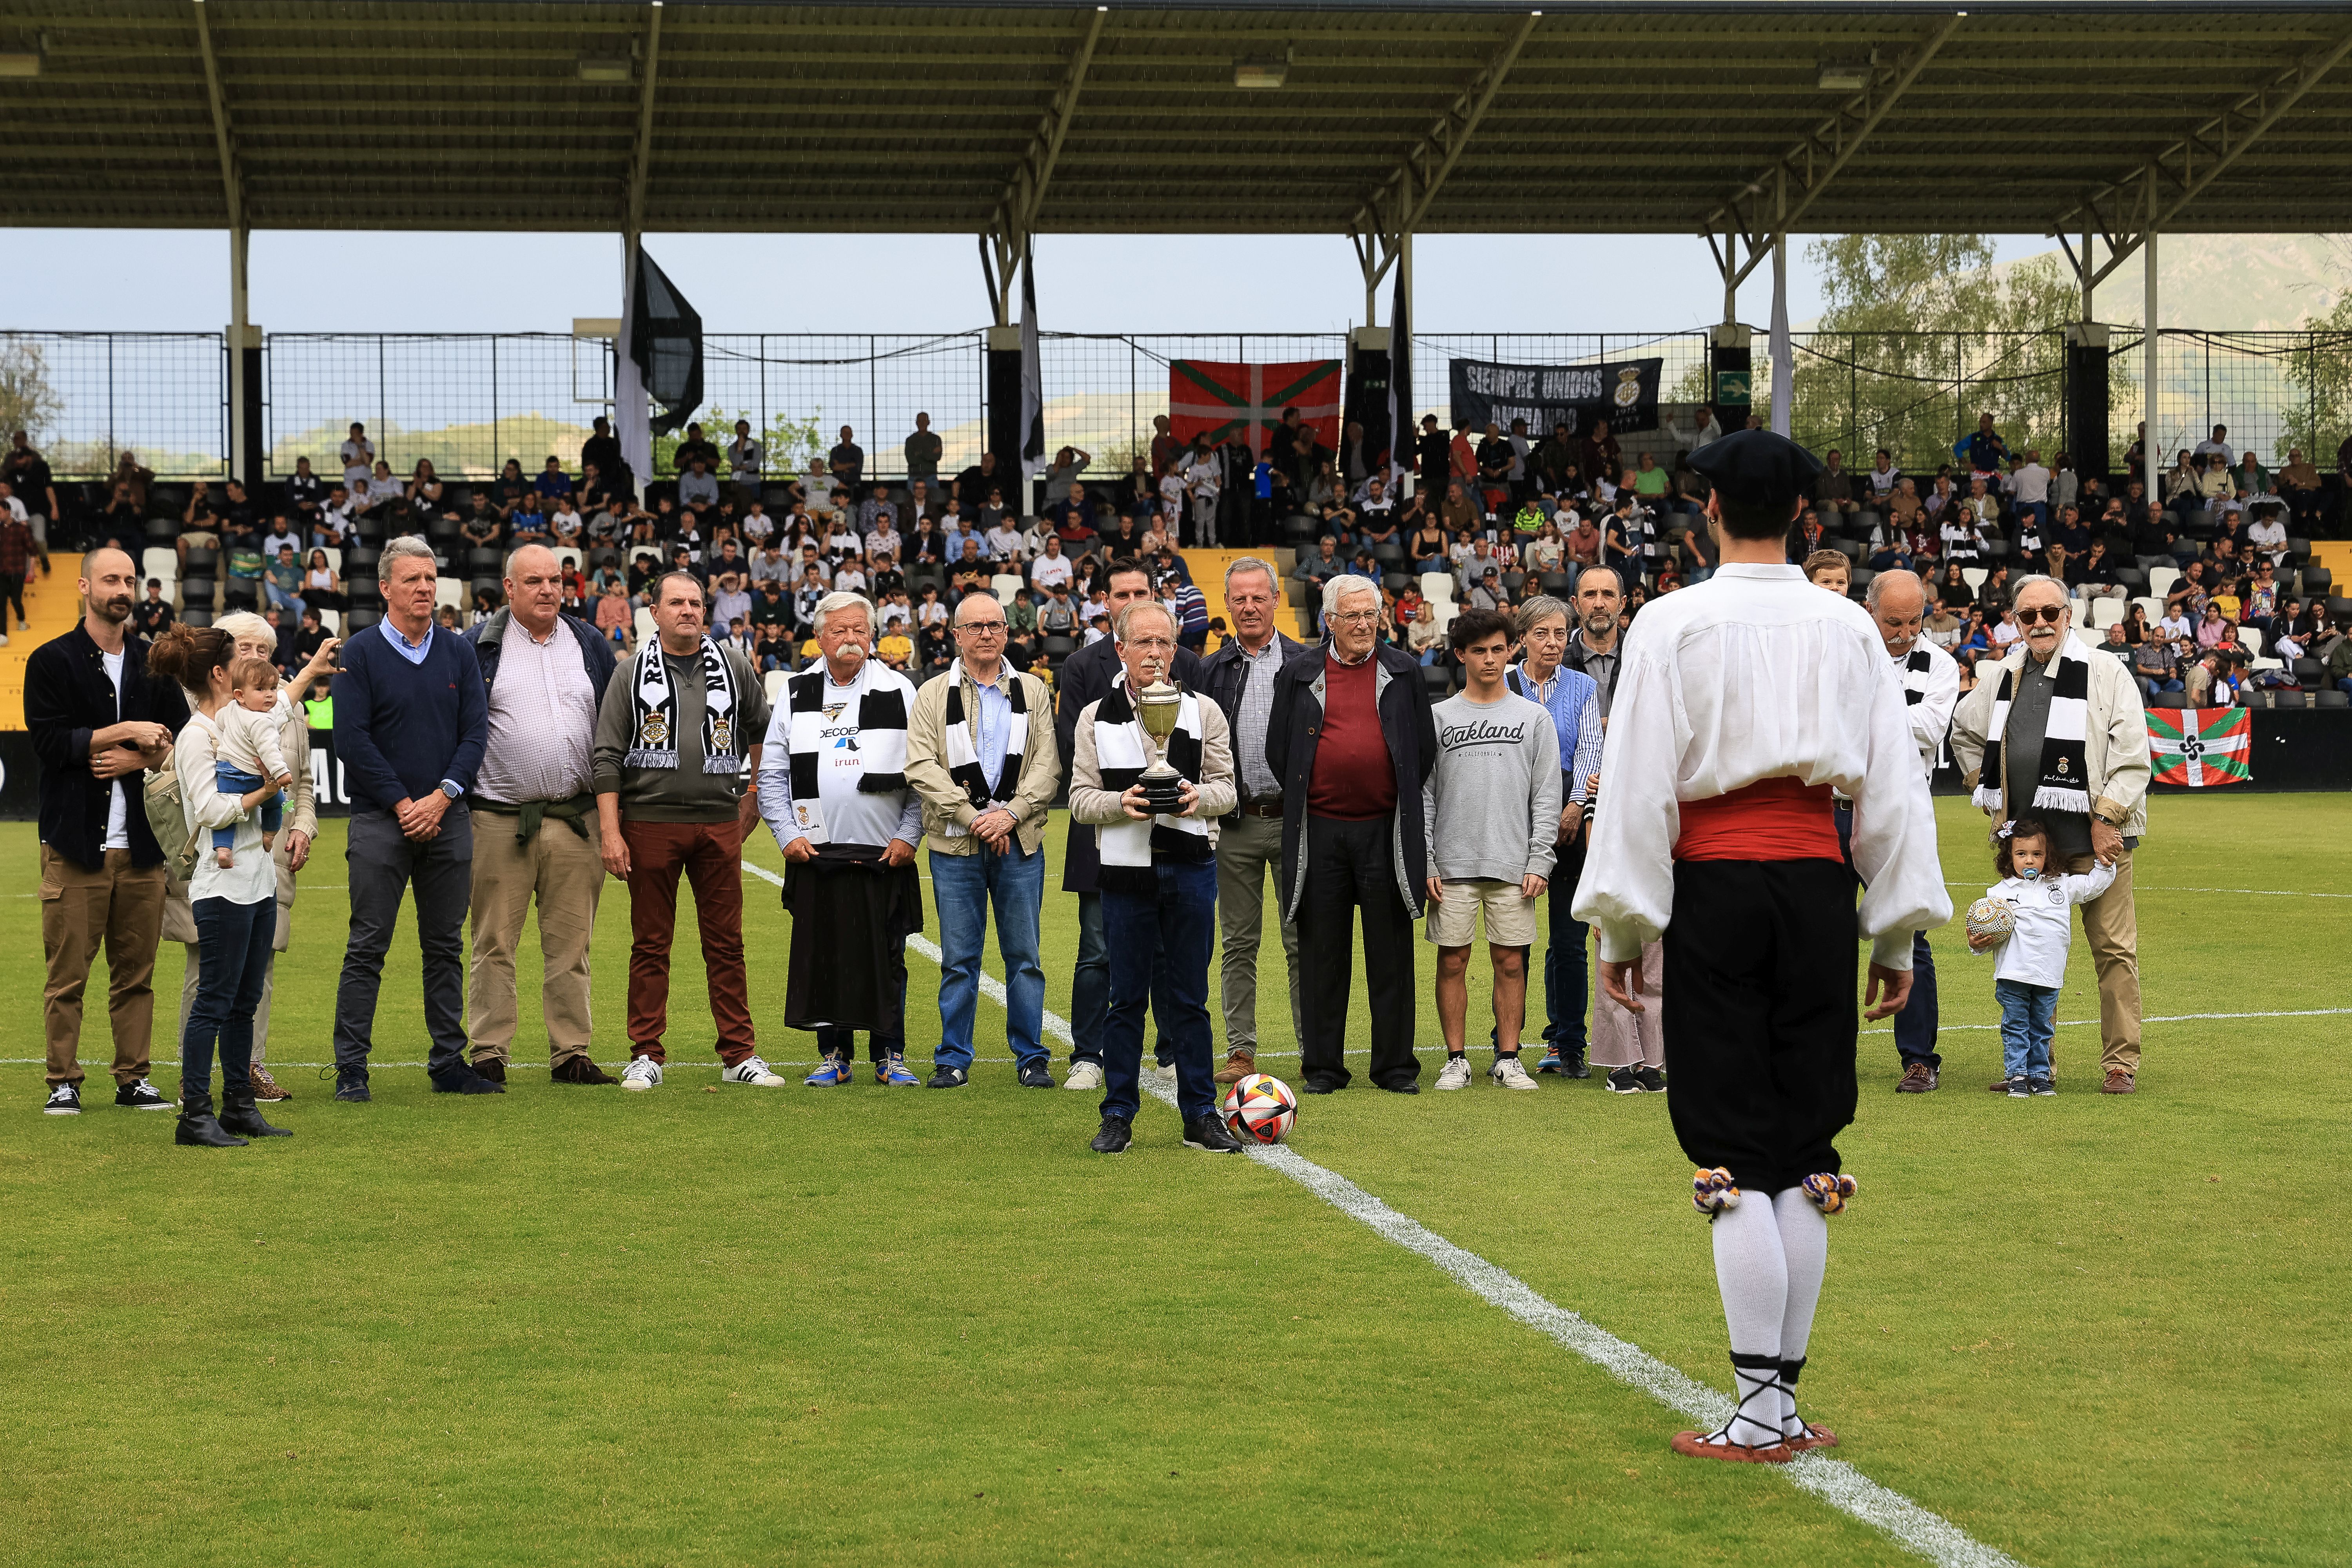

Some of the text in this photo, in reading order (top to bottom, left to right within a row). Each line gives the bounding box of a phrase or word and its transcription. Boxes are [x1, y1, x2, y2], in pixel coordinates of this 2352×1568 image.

[1466, 366, 1602, 399] SIEMPRE UNIDOS
[1441, 719, 1524, 750] Oakland
